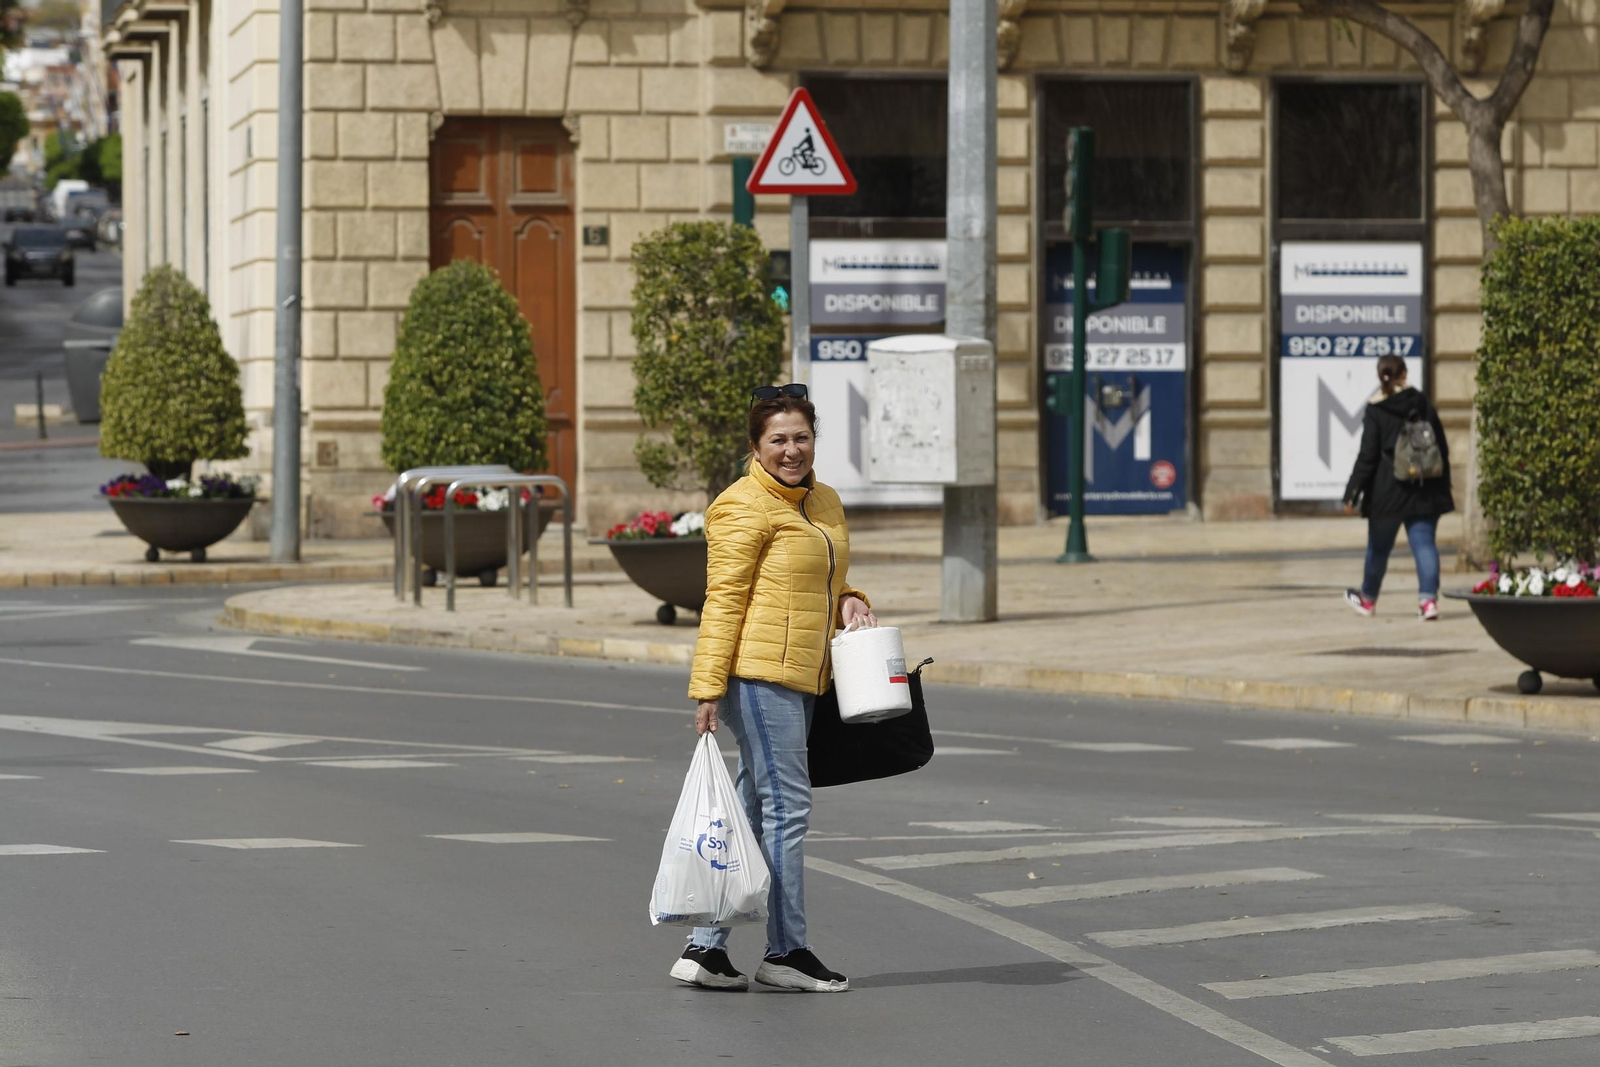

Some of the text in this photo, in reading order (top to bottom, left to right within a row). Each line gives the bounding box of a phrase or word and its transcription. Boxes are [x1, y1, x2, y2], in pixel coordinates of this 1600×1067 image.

[824, 294, 939, 312] DISPONIBLE
[1295, 305, 1407, 323] DISPONIBLE
[1054, 316, 1167, 334] DIPONIBLE
[818, 340, 862, 360] 950
[1288, 337, 1414, 356] 950 27 25 17
[1096, 349, 1120, 365] 27
[1126, 349, 1151, 365] 25
[1156, 349, 1174, 365] 17
